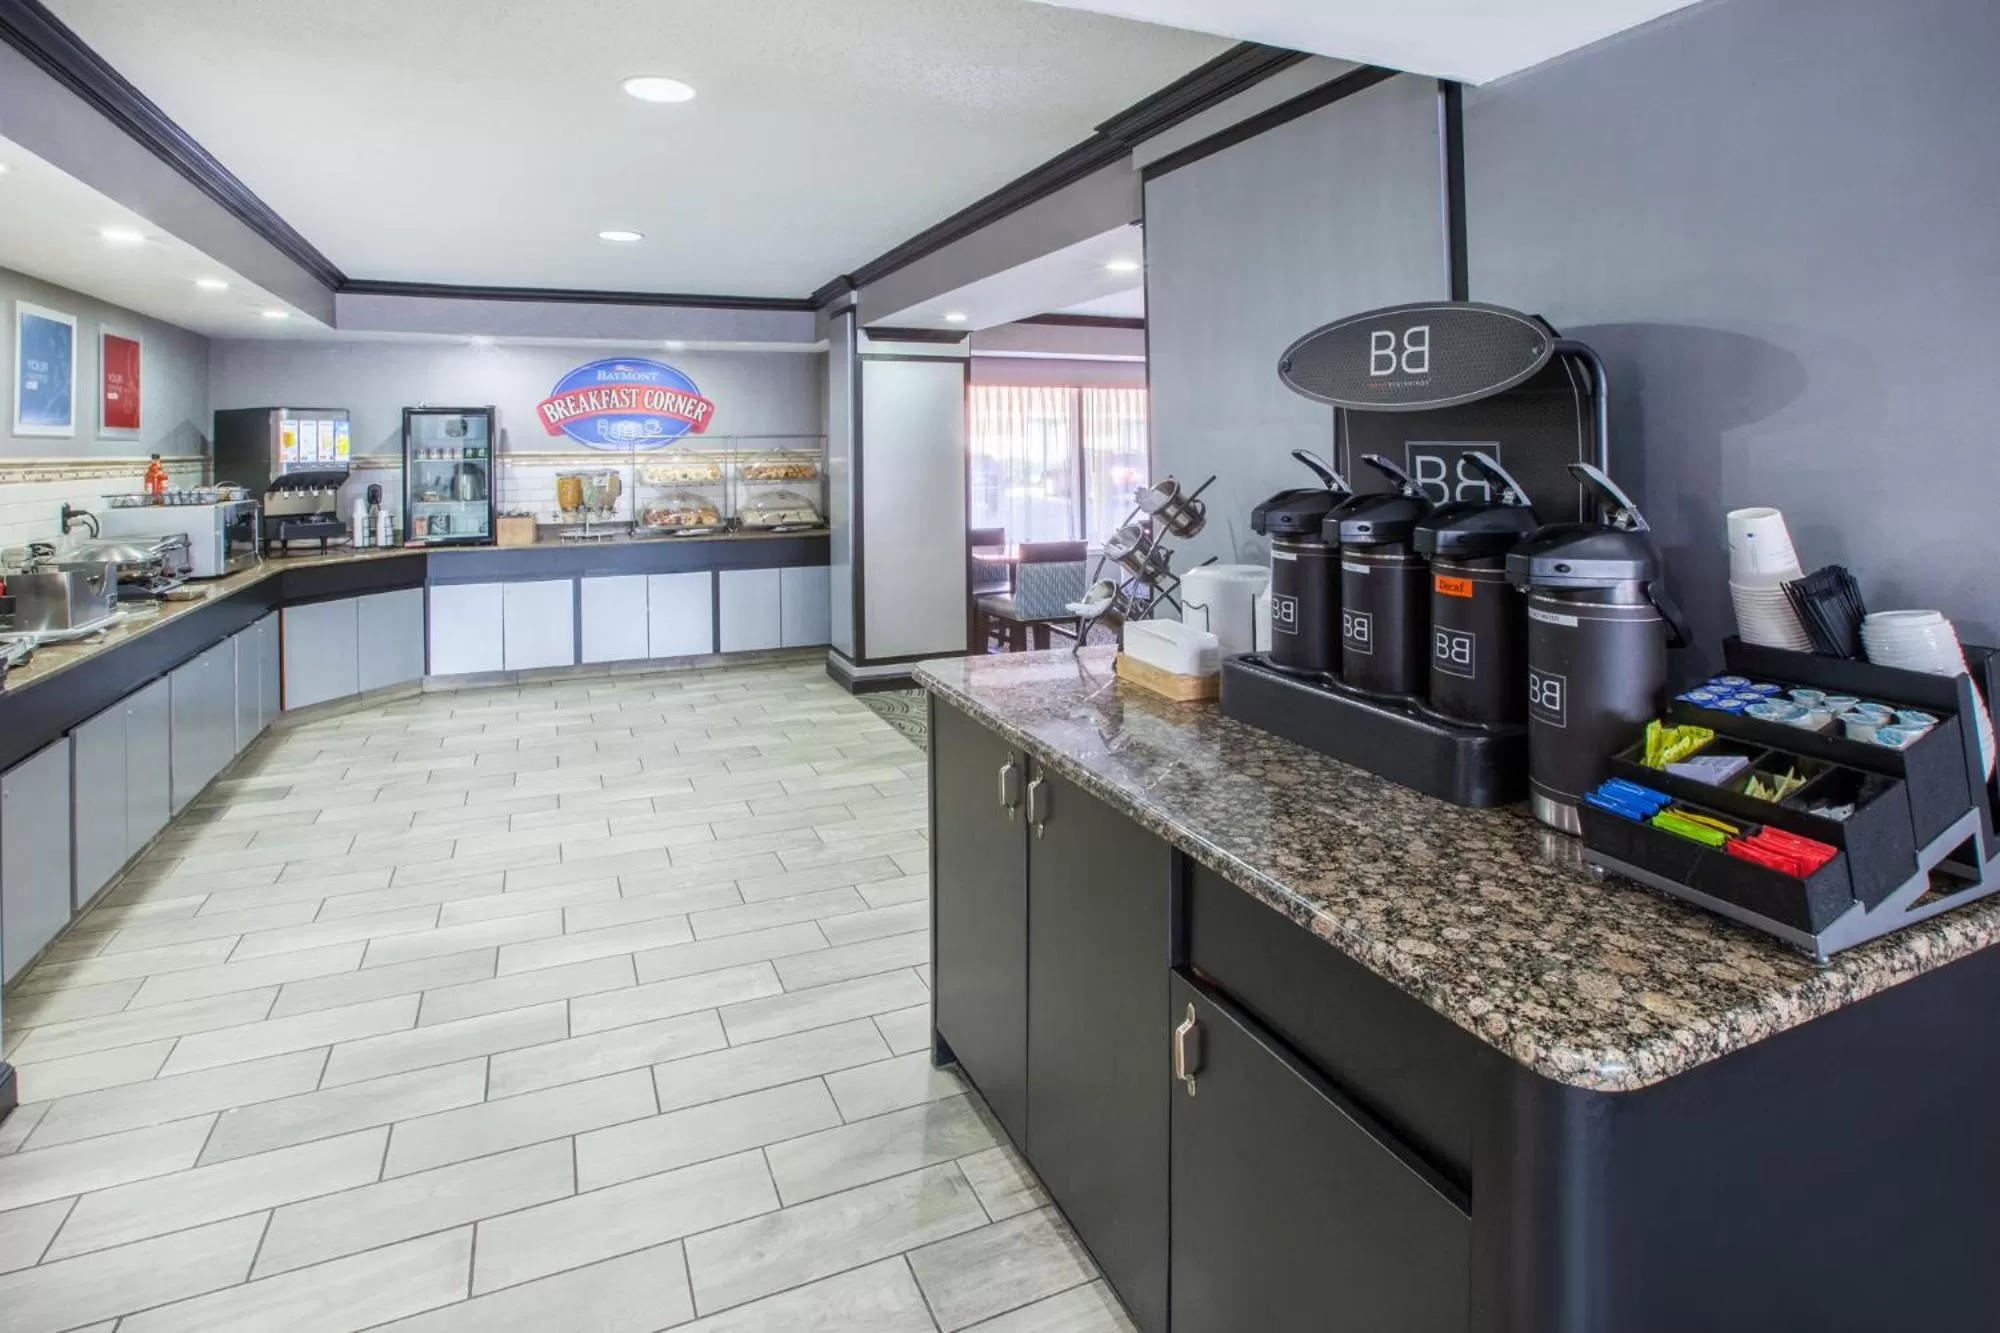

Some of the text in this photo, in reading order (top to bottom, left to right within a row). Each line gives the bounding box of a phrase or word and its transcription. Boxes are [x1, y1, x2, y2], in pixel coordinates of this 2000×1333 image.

[596, 370, 661, 381] BAYMONT
[542, 388, 708, 423] BREAKFAST CORNER
[1439, 582, 1464, 594] Decaf
